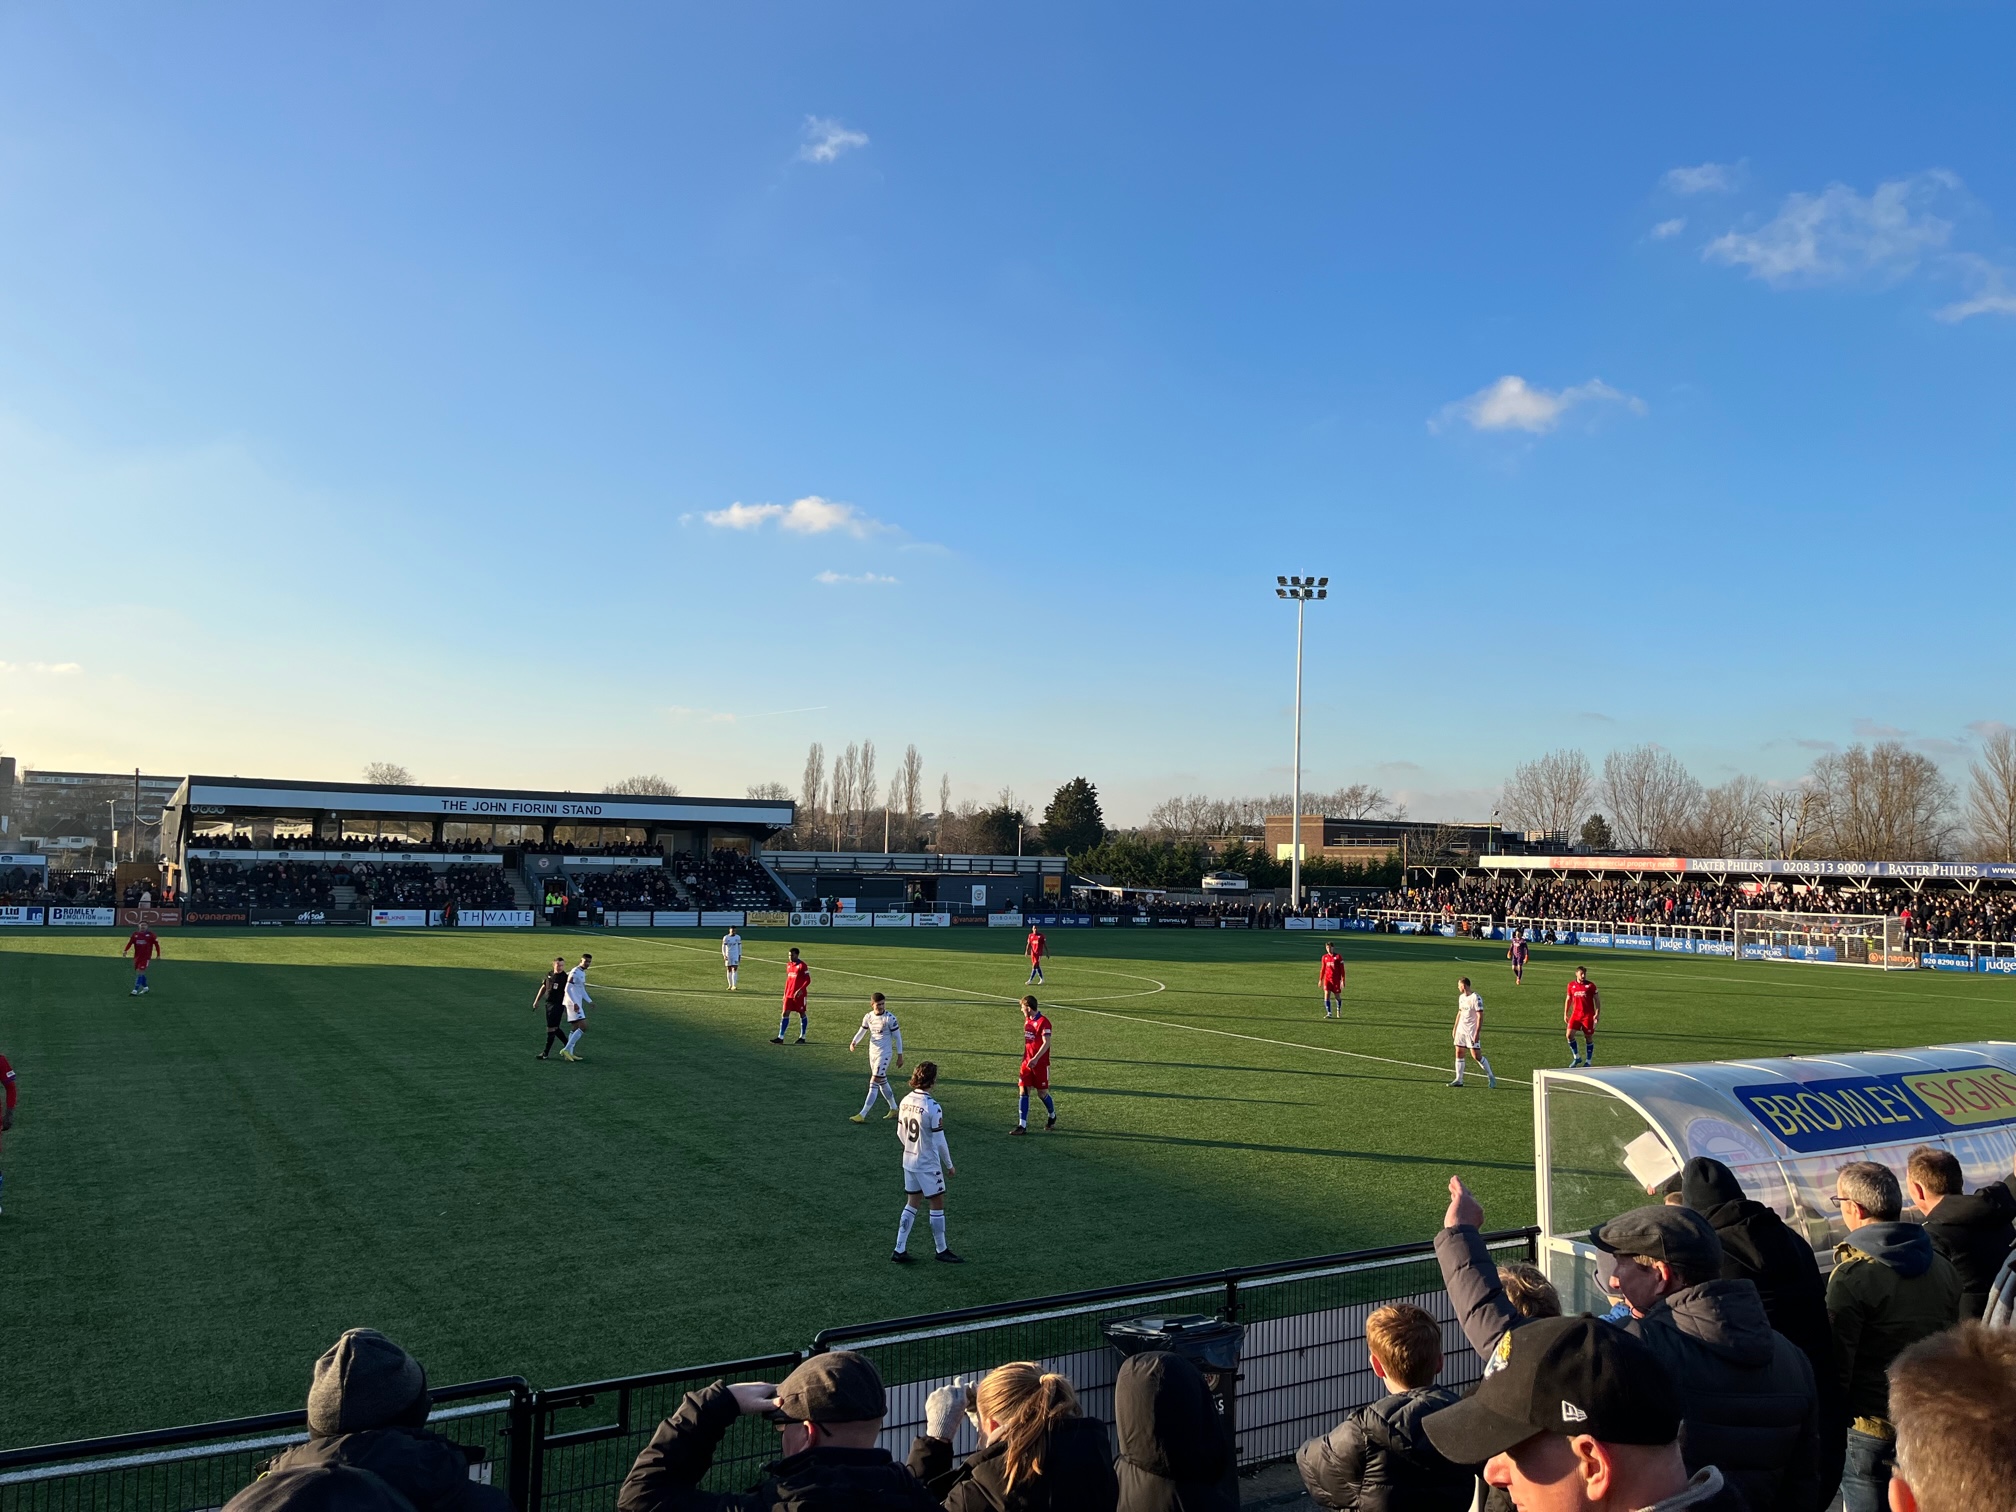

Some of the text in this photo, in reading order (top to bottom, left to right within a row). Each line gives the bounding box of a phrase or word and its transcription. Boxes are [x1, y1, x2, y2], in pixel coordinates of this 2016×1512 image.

[442, 800, 602, 815] THE JOHN FIORINI STAND
[1627, 861, 1656, 869] property
[1692, 860, 1764, 871] BAXTER PHILIPS
[1783, 862, 1865, 873] 0208 313 9000
[1888, 864, 1977, 876] BAXTER PHILIPS
[1660, 939, 1692, 950] judge &
[1985, 958, 2016, 973] judge
[1750, 1084, 1923, 1136] BROMLEY
[904, 1117, 919, 1142] 19
